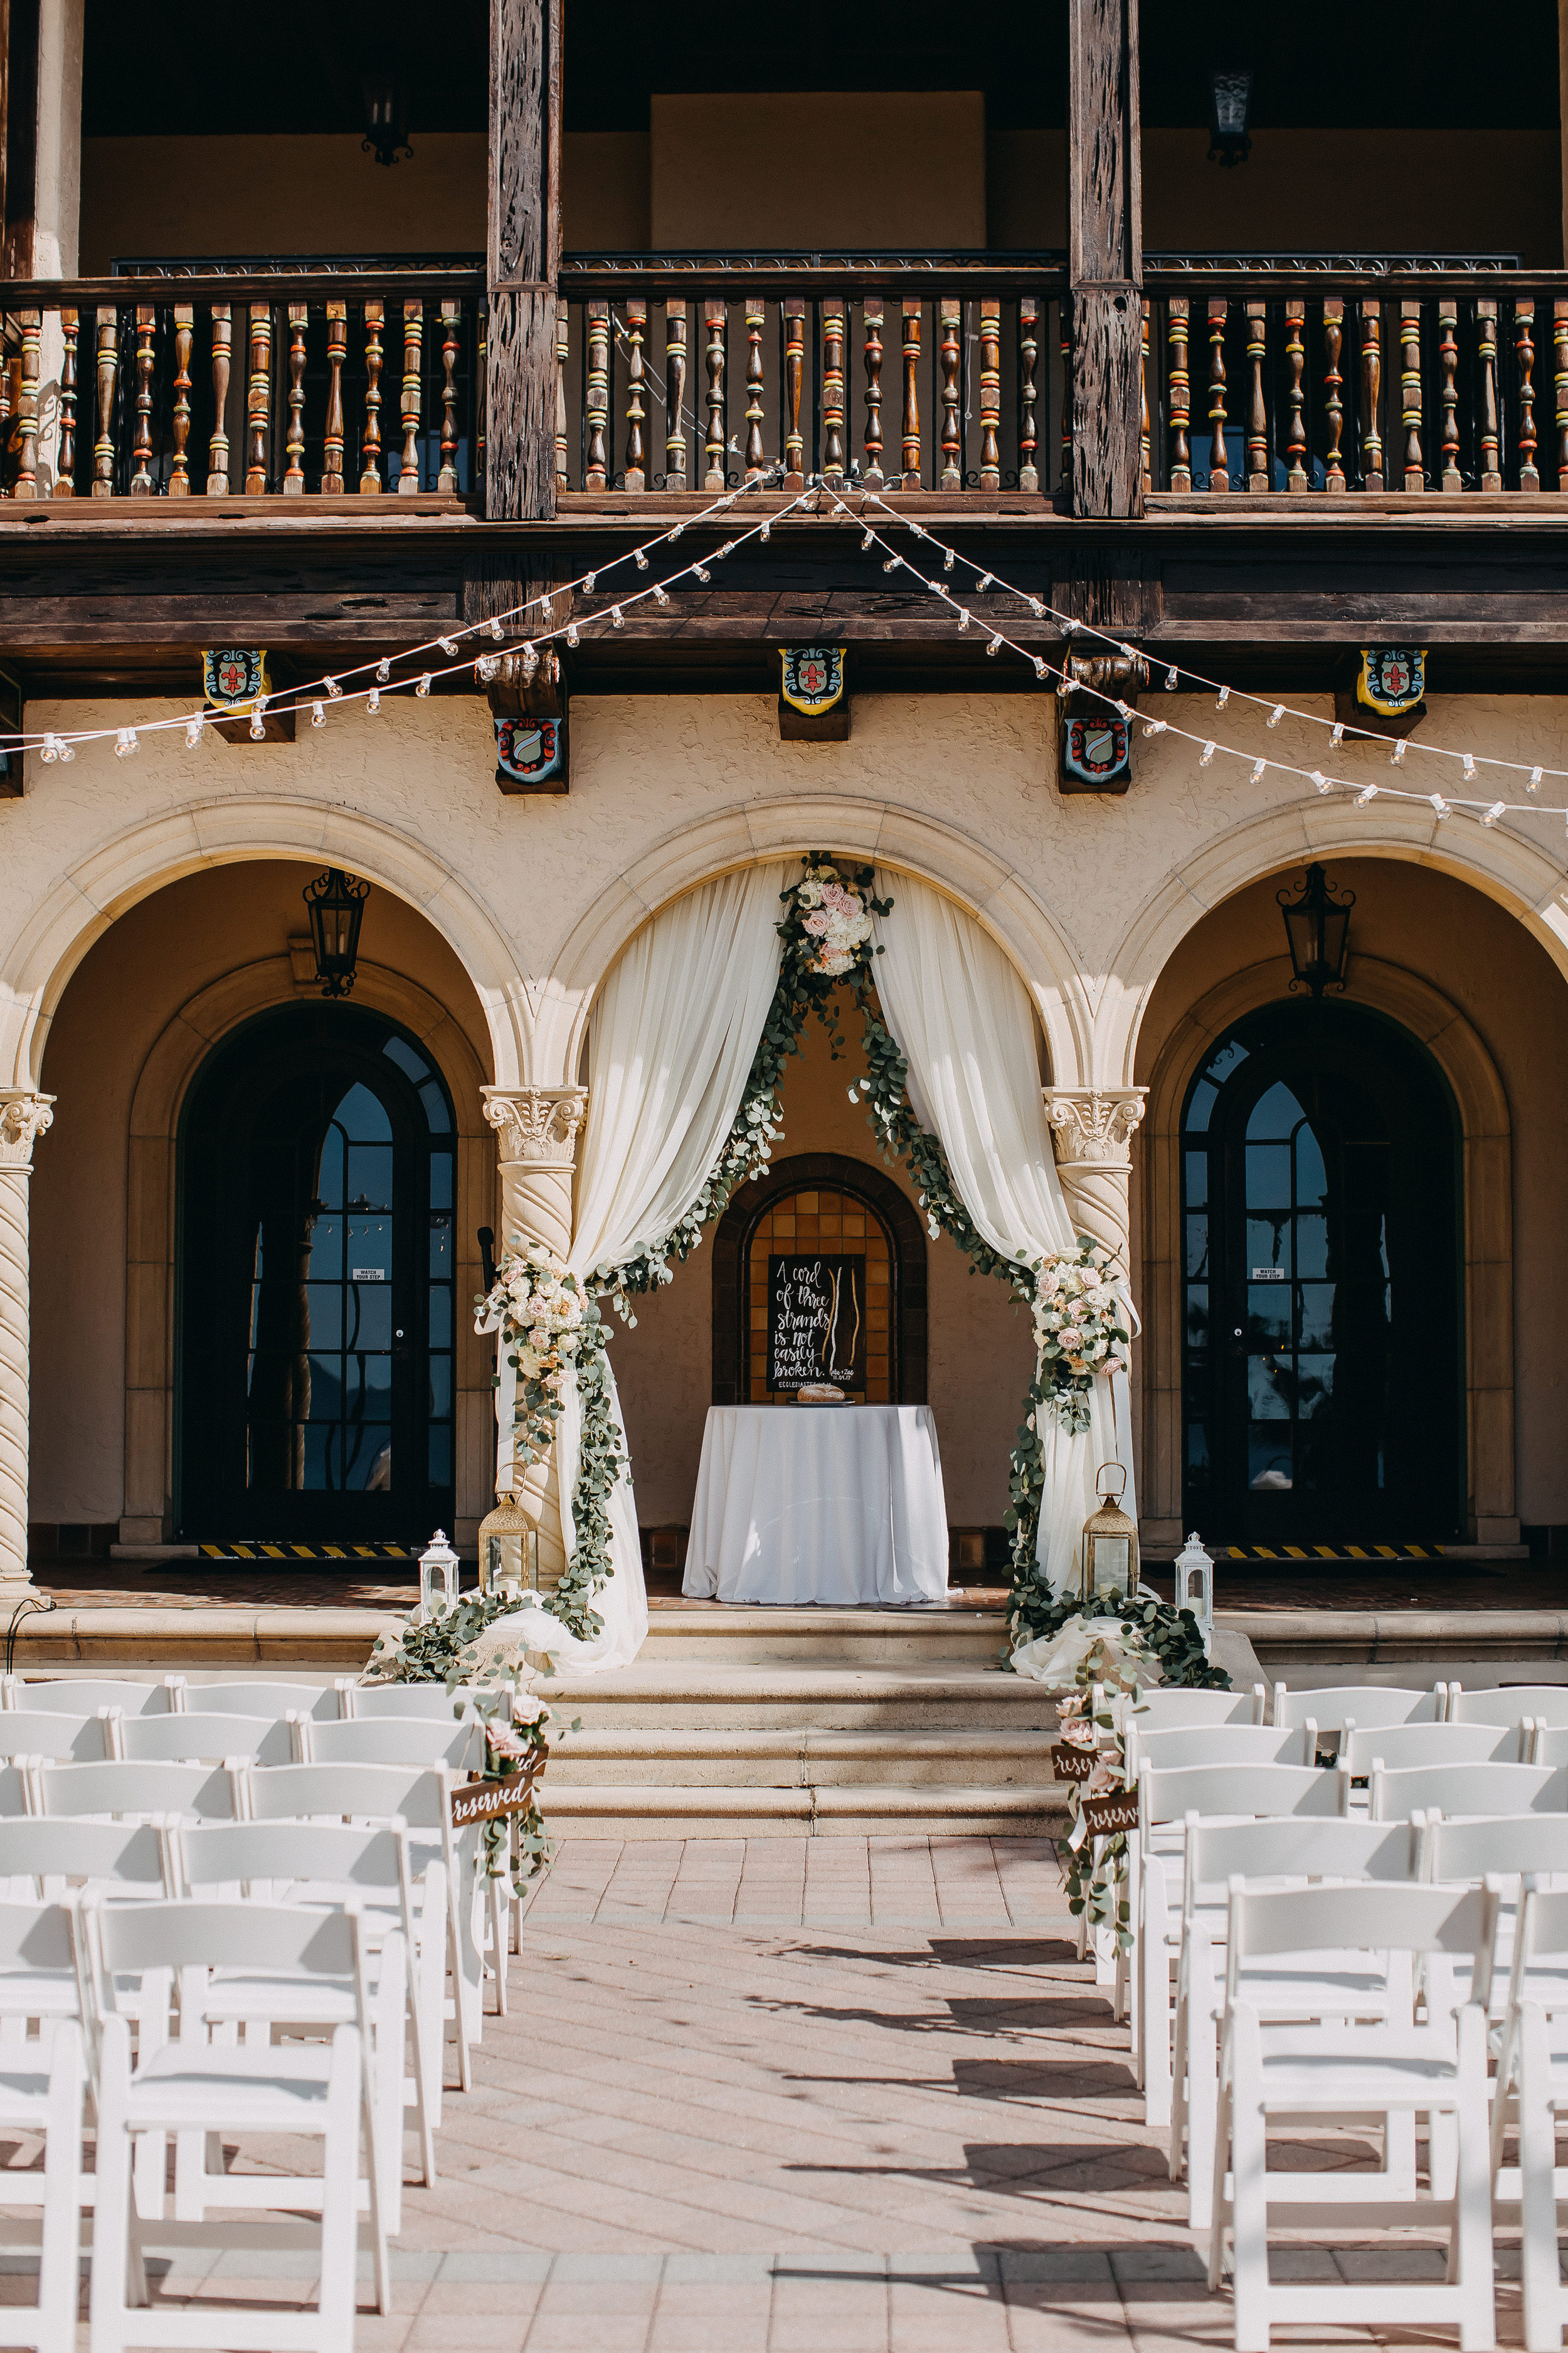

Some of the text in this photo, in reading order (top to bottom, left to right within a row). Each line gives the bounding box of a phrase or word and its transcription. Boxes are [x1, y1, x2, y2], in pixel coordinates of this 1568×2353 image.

[776, 1261, 822, 1288] A cord
[776, 1283, 830, 1310] of three
[778, 1308, 830, 1331] strands
[775, 1329, 815, 1347] is not
[774, 1346, 822, 1368] easily
[772, 1361, 825, 1379] broken.
[452, 1777, 533, 1820] reserved
